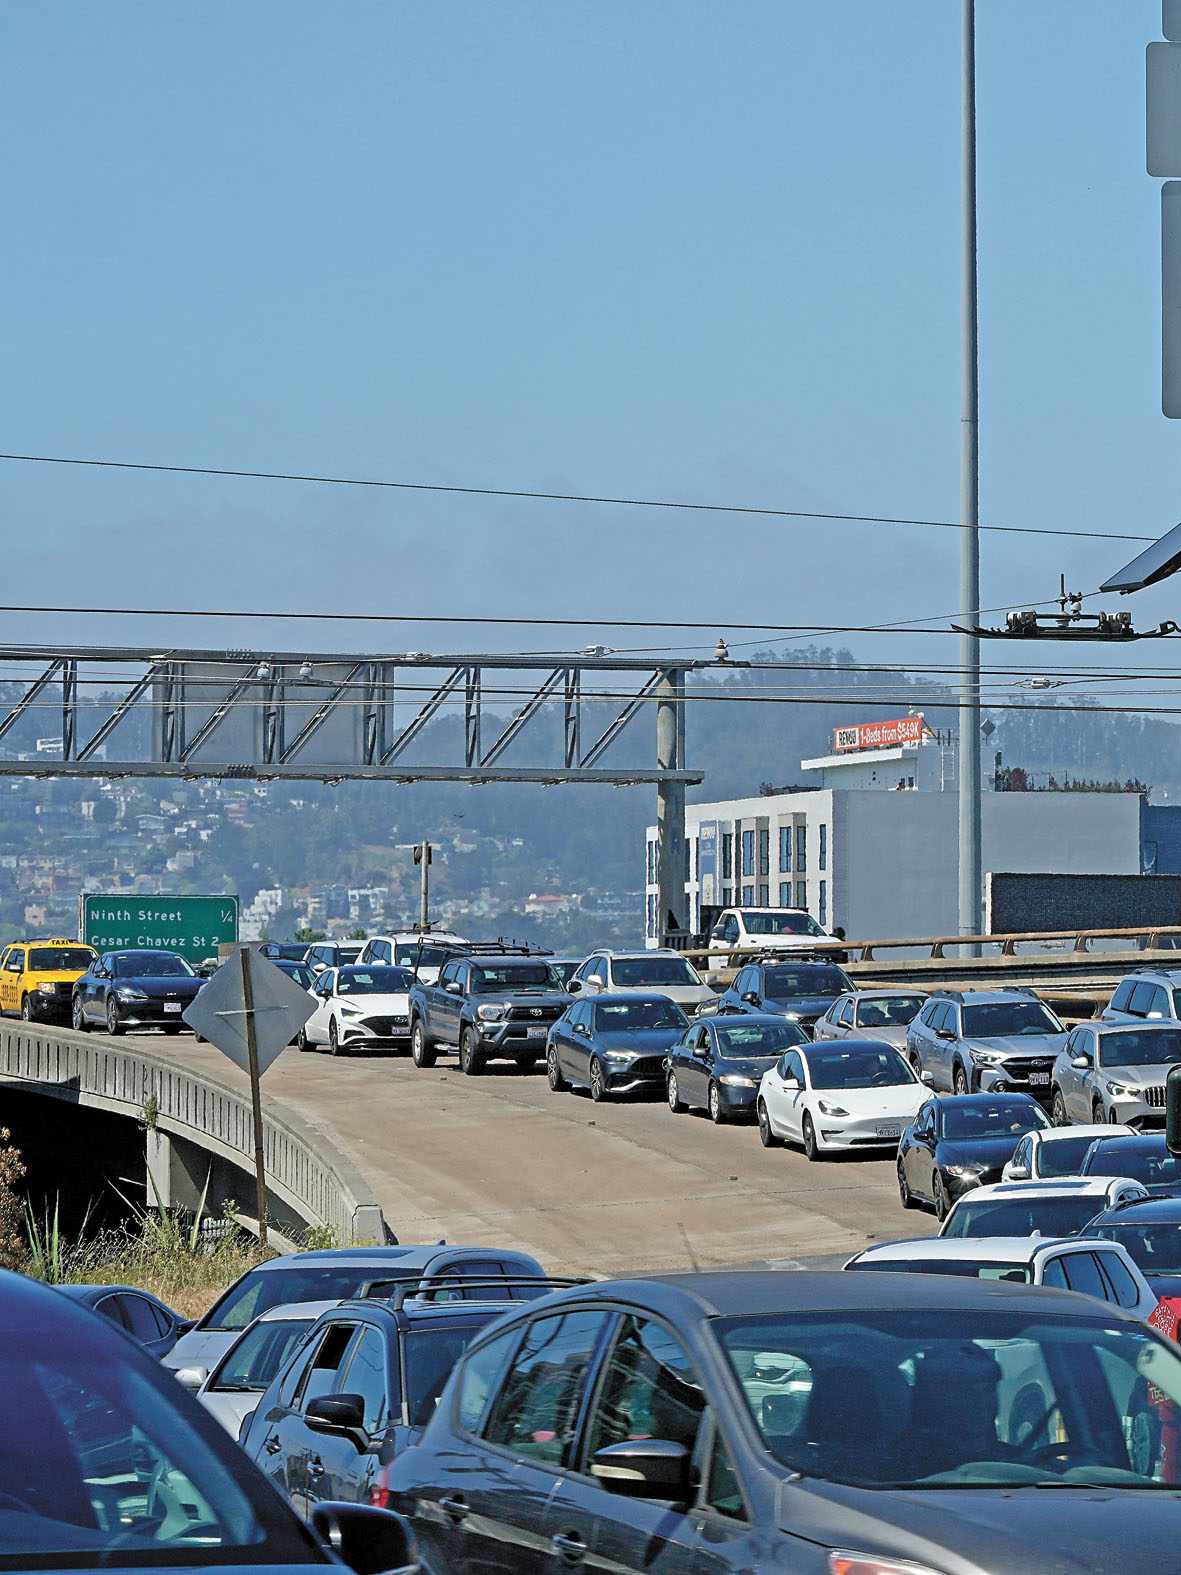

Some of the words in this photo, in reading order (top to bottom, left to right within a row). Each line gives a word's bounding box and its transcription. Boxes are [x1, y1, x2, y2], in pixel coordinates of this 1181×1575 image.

[881, 726, 897, 741] from
[90, 909, 131, 922] Ninth
[138, 909, 182, 922] Street
[91, 935, 130, 947] Cesar
[137, 935, 186, 947] Chavez
[192, 936, 206, 948] St
[210, 936, 220, 947] 2
